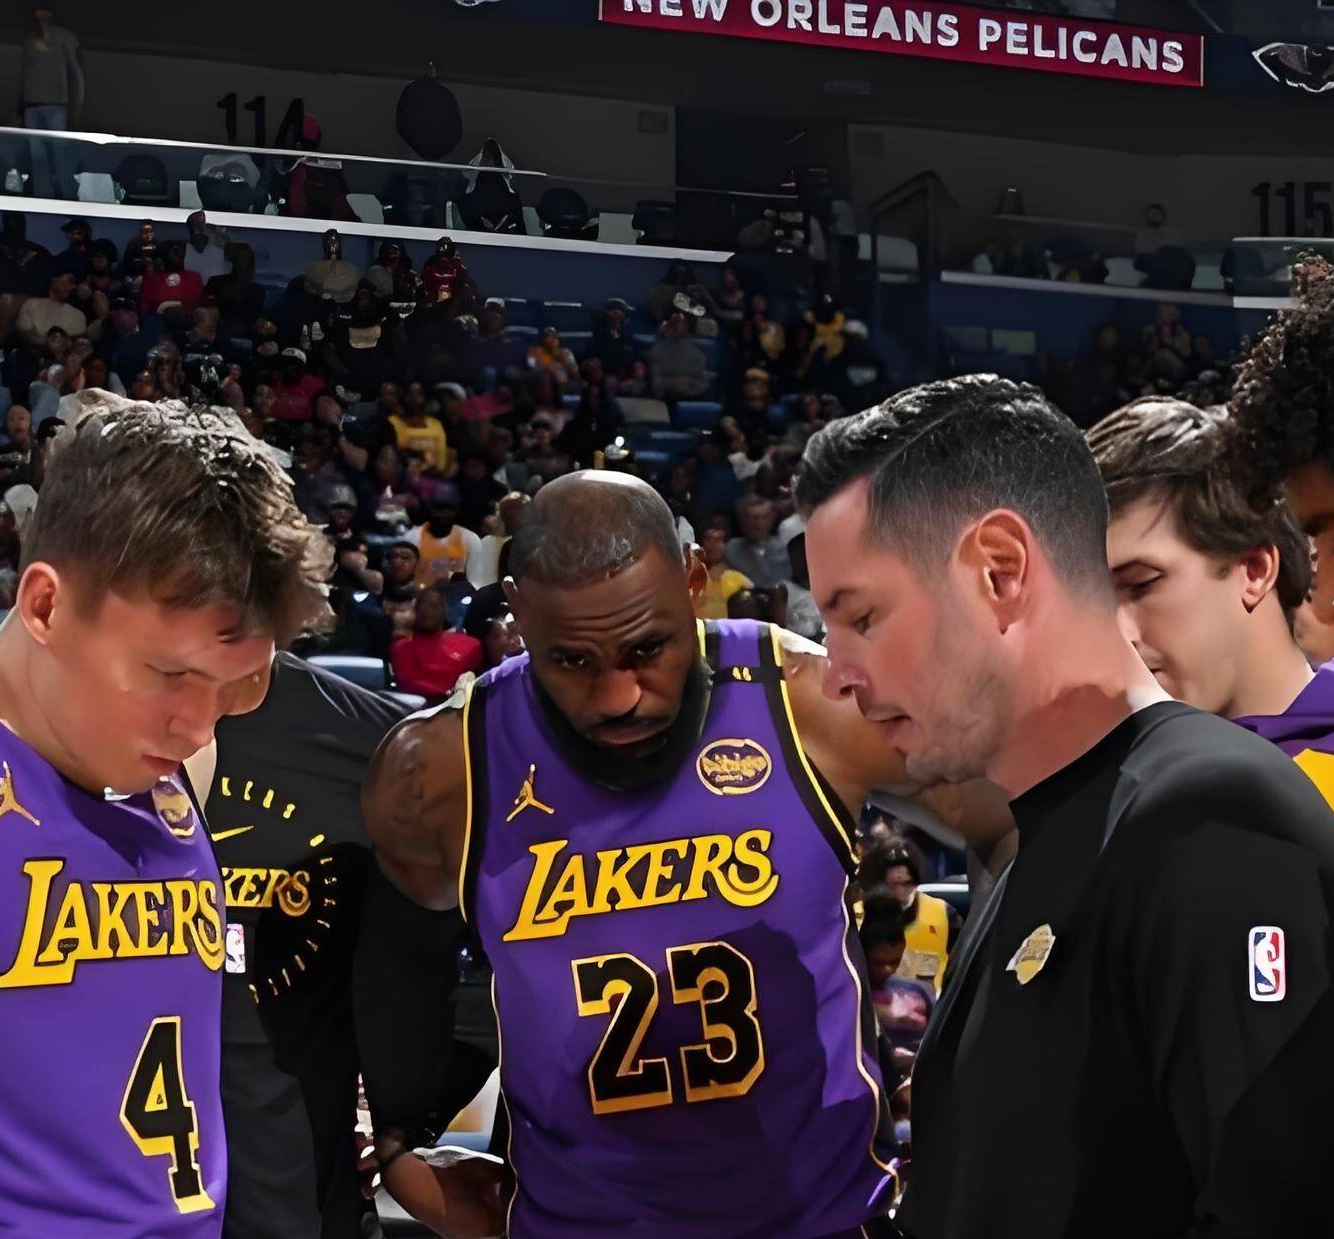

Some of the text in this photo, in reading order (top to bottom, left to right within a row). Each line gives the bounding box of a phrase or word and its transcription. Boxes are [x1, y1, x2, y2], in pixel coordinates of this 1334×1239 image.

[750, 0, 959, 47] ORLEANS
[978, 18, 1185, 73] PELICANS
[1251, 182, 1333, 237] 115
[501, 829, 779, 942] LAKERS
[571, 940, 766, 1116] 23
[119, 1014, 216, 1215] 4
